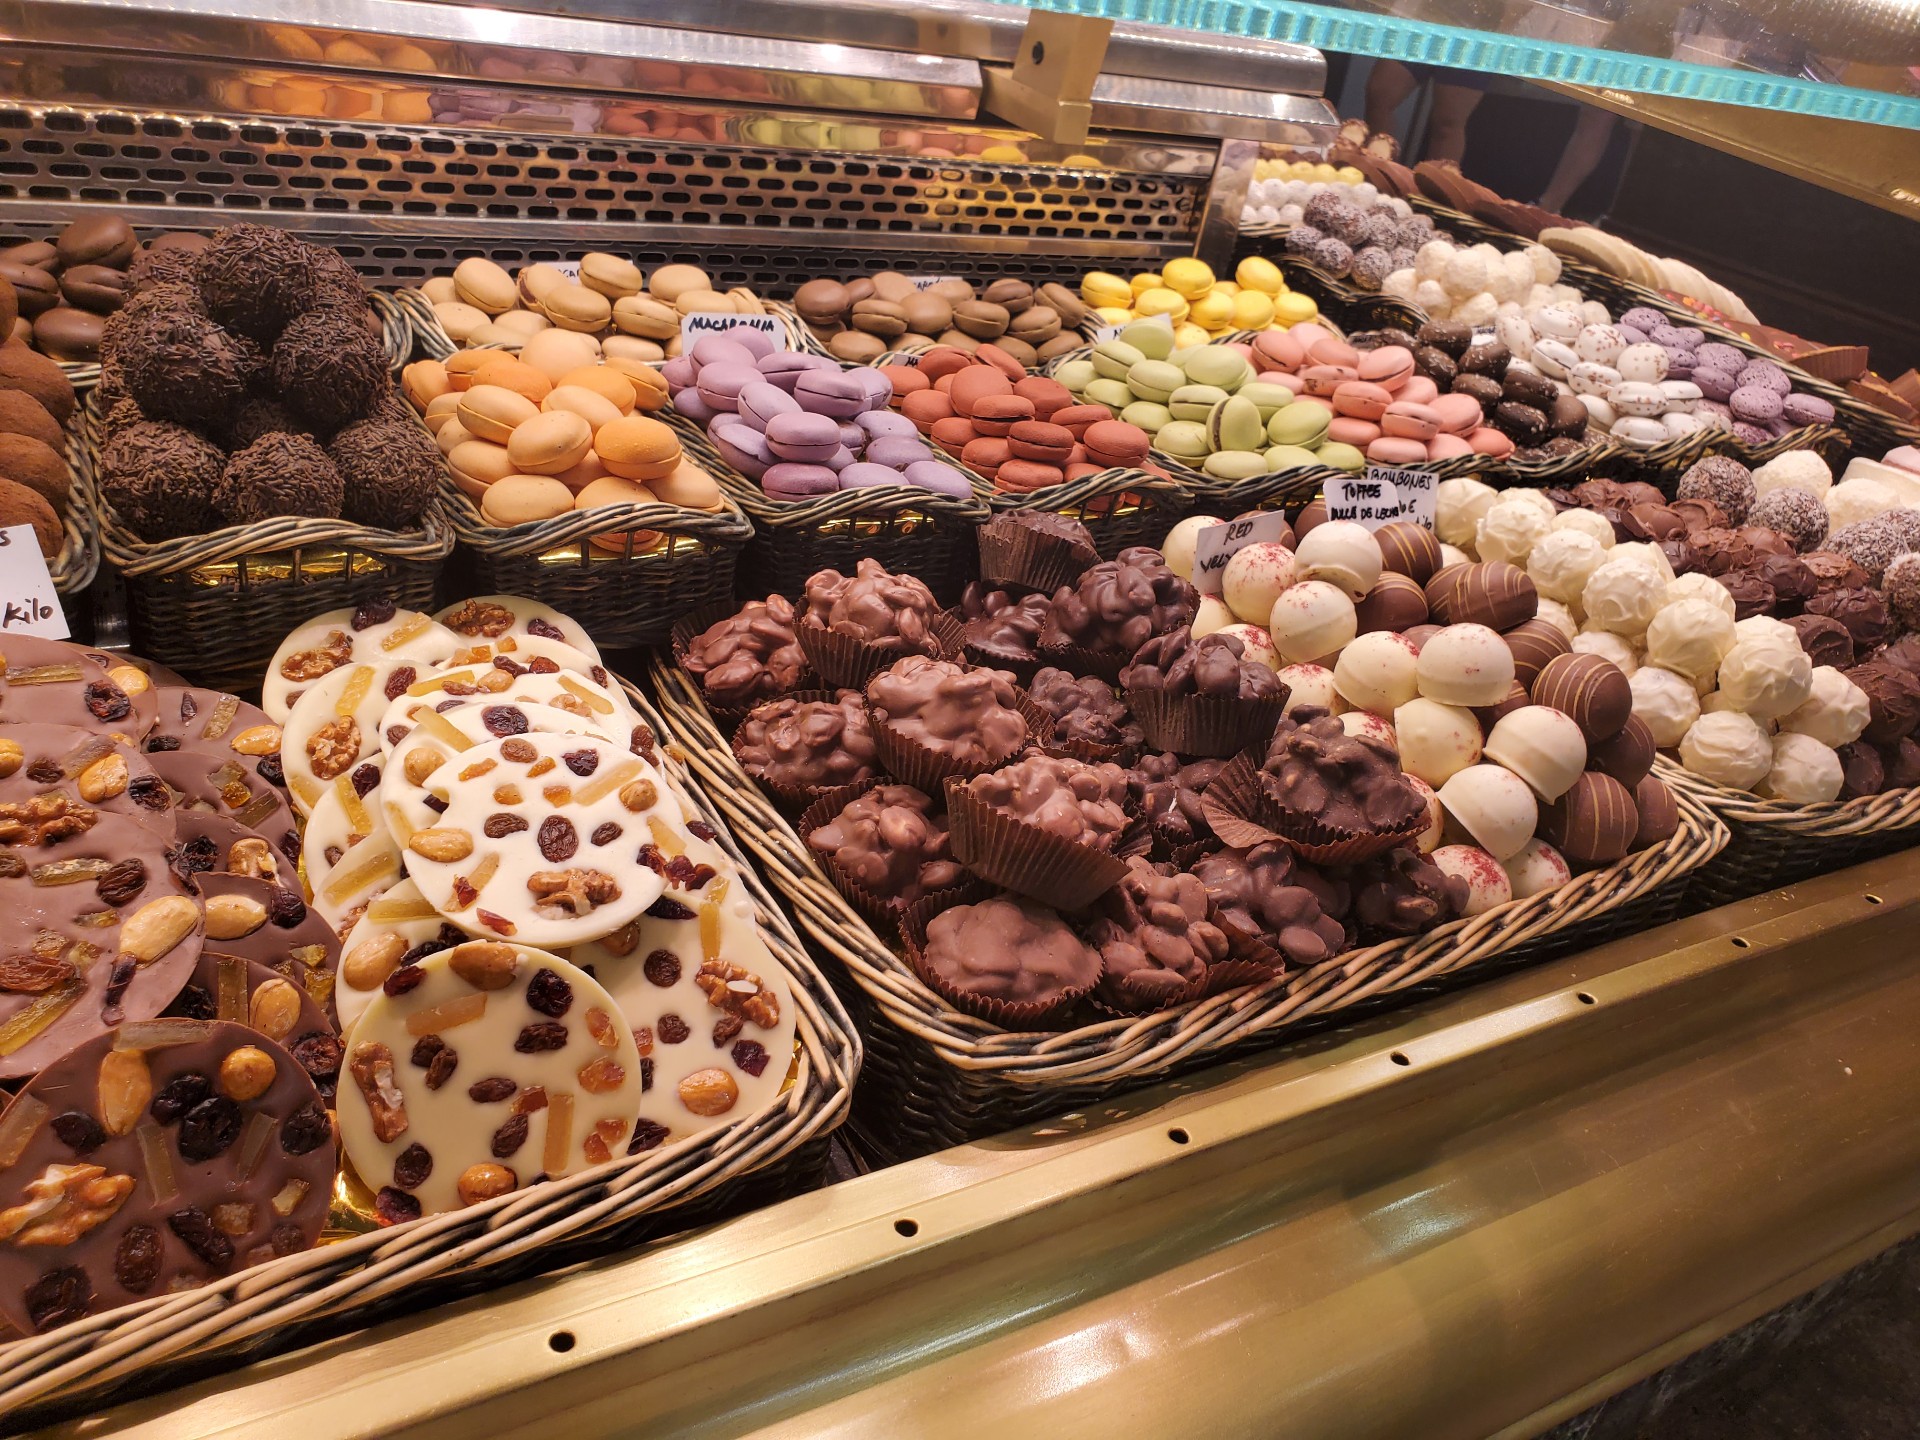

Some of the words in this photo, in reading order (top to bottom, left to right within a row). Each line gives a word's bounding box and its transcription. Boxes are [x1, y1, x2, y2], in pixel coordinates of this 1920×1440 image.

[1341, 482, 1382, 502] TOFFEE
[1330, 506, 1358, 521] DULCE
[1360, 507, 1373, 520] DE
[1223, 521, 1254, 546] RED
[2, 597, 54, 629] Kilo
